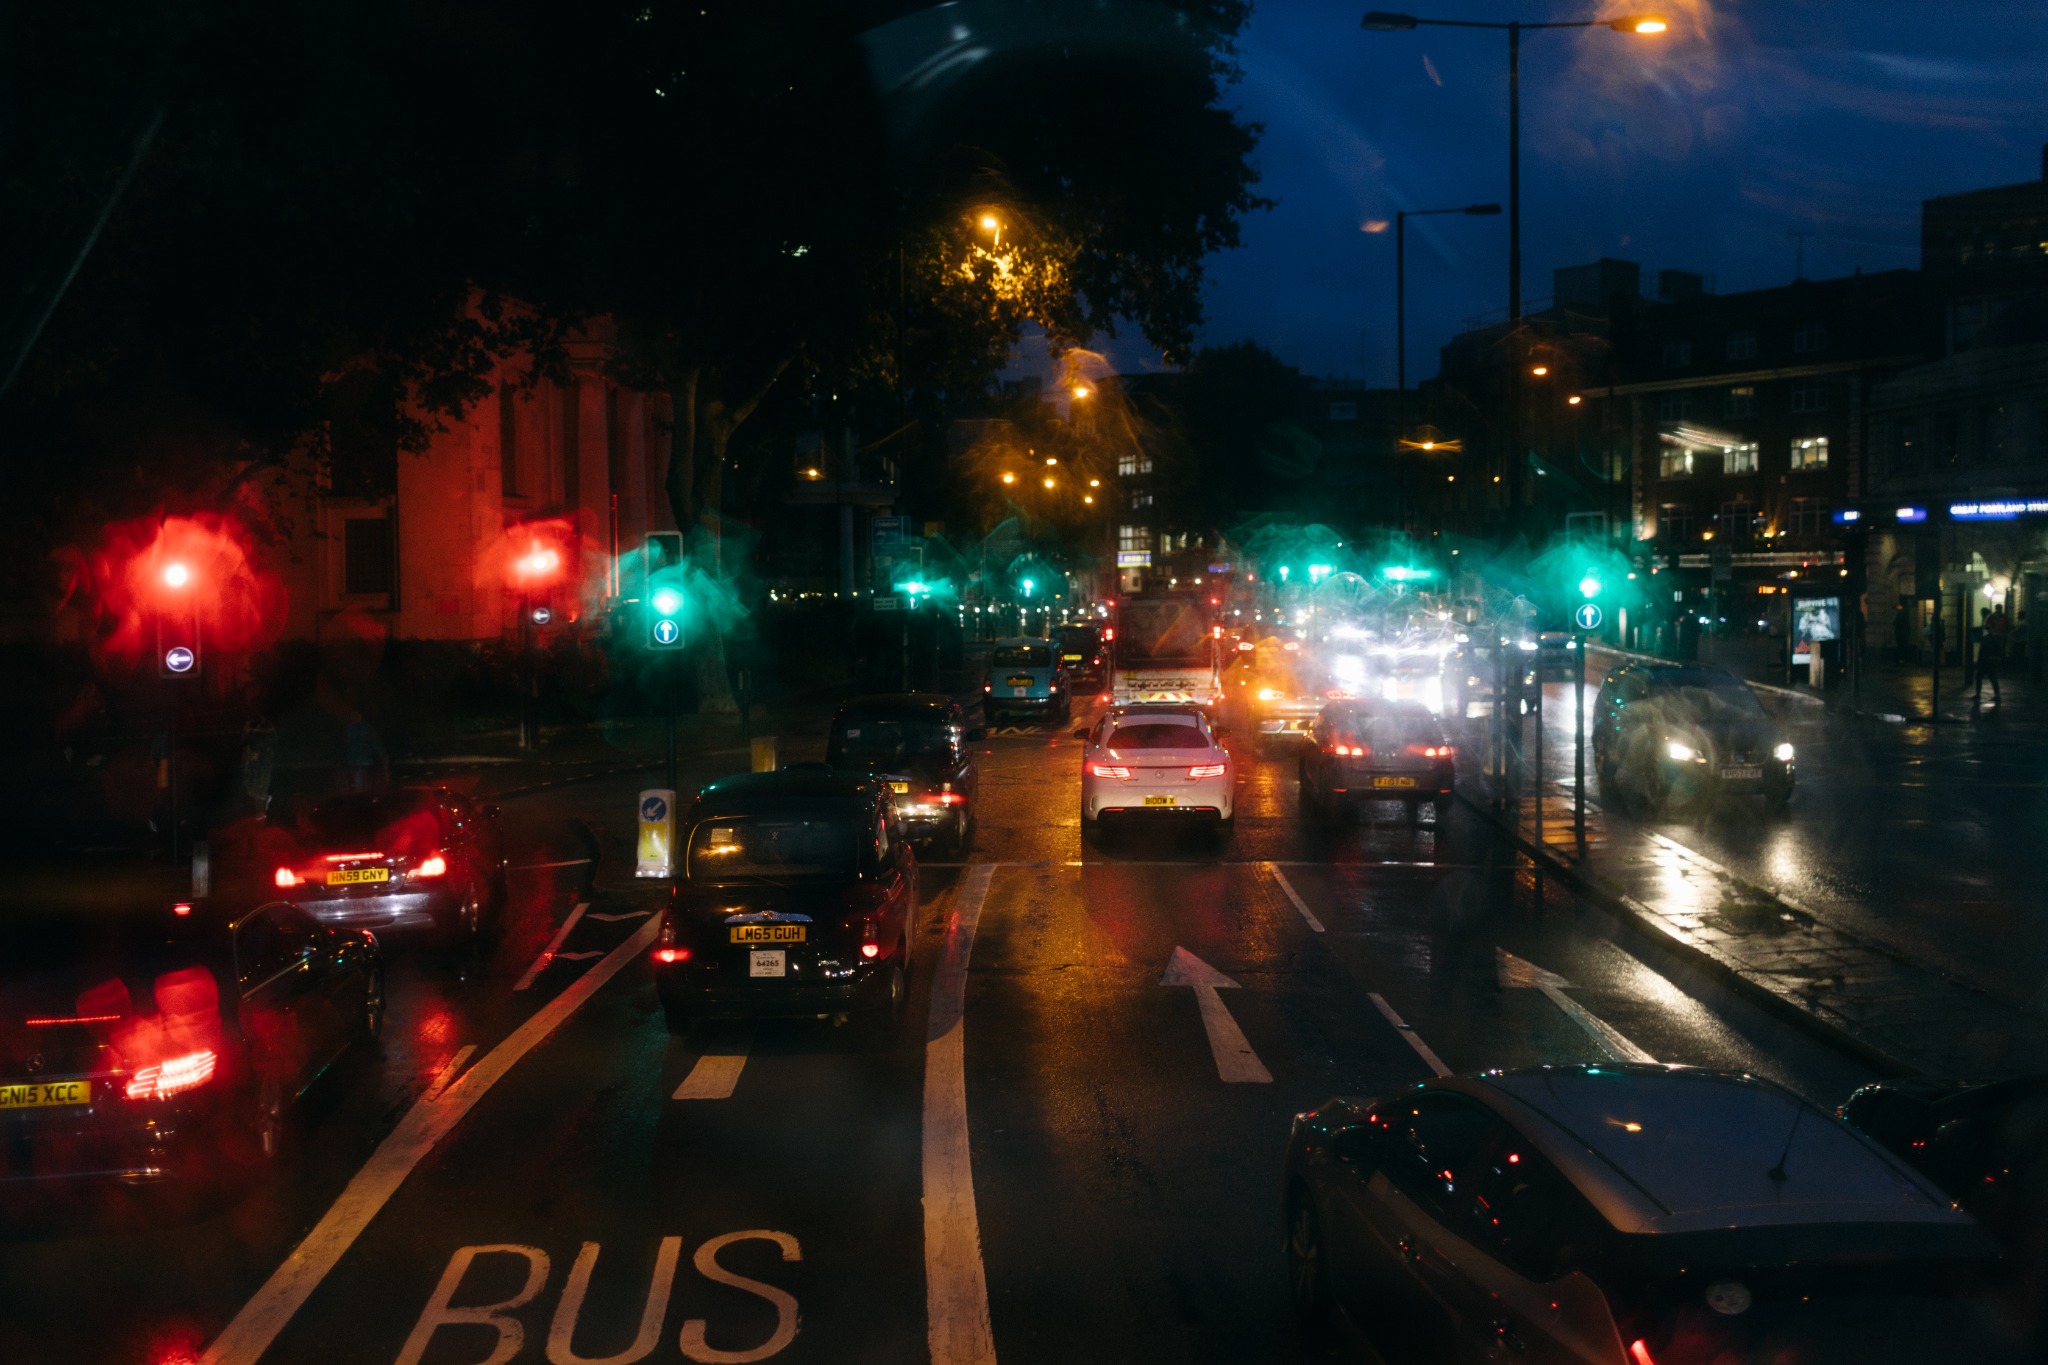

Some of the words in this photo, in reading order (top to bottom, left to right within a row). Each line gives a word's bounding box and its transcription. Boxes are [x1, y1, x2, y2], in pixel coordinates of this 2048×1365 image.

[1950, 505, 1978, 514] GREAT
[1979, 504, 2026, 513] PORTLAND
[331, 871, 360, 882] HN59
[362, 870, 384, 880] GNY
[736, 928, 771, 940] LM65
[774, 927, 800, 940] GUH
[0, 1086, 38, 1105] GN15
[43, 1084, 79, 1103] XCC
[394, 1229, 804, 1365] BUS
